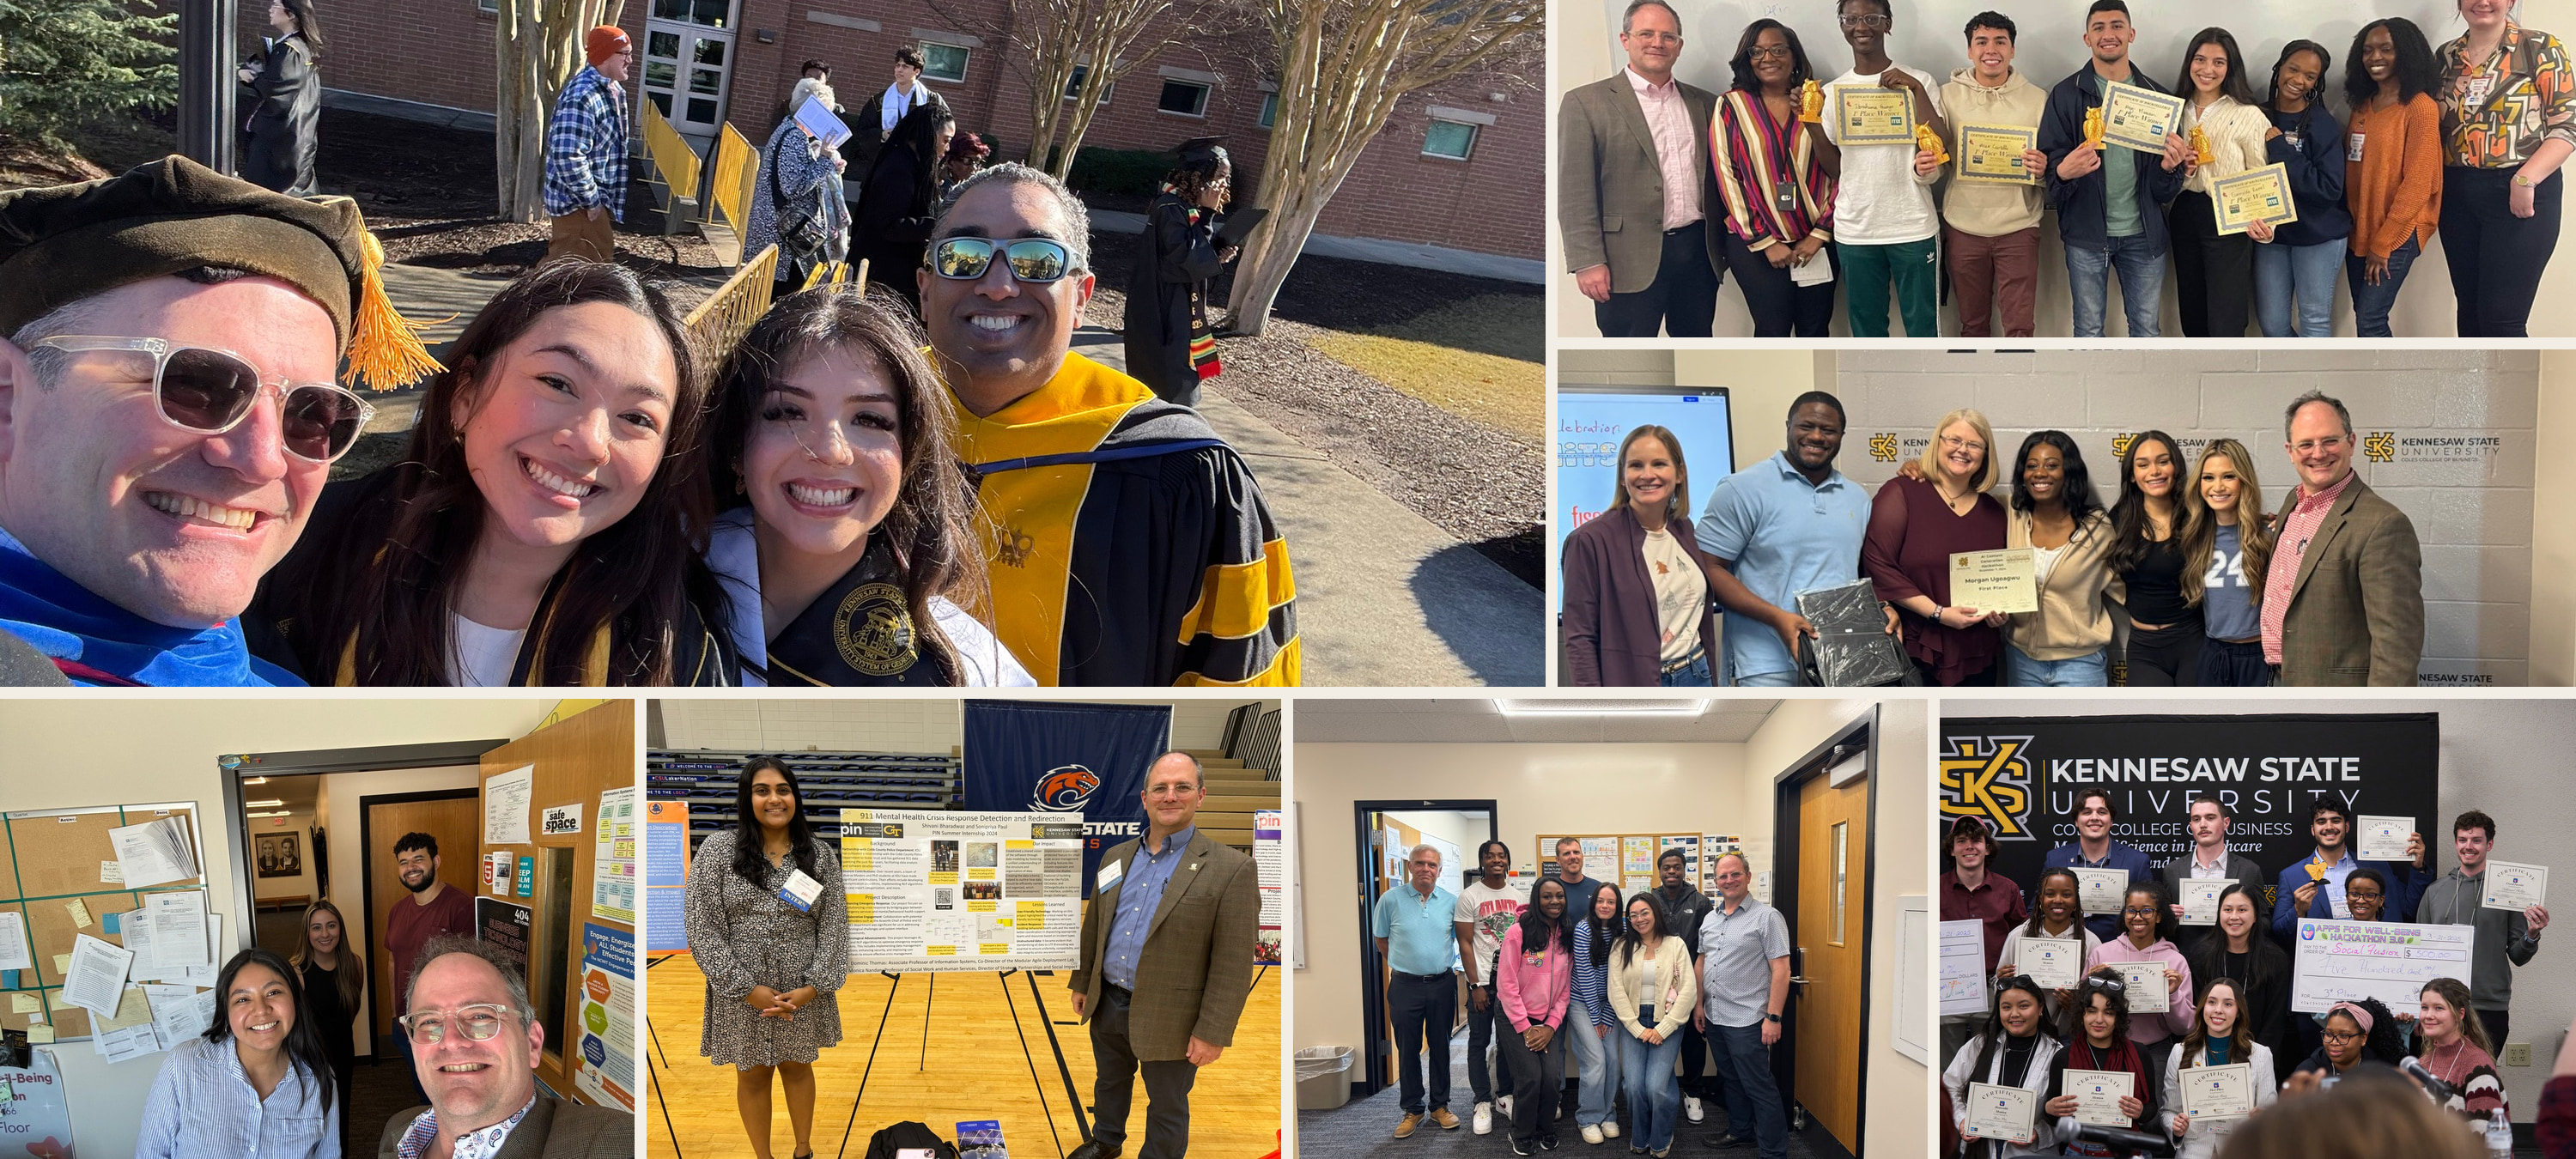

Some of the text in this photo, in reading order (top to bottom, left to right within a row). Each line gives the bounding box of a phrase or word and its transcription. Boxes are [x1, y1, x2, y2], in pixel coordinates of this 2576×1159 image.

[2402, 437, 2500, 446] KENNESAW STATE
[2402, 447, 2500, 456] UNIVERSITY
[2204, 550, 2251, 588] 24
[2419, 674, 2493, 683] NESAW STATE
[2052, 757, 2360, 783] KENNESAW STATE
[2052, 789, 2360, 815] UIVERSITY
[549, 809, 565, 821] safe
[1259, 814, 1280, 829] pin
[546, 818, 577, 833] space
[841, 822, 862, 835] pin
[1083, 822, 1141, 835] STATE
[2109, 823, 2182, 836] COLLEGE
[2120, 840, 2168, 853] Science
[2172, 839, 2185, 852] in
[2080, 874, 2117, 885] CERTIFICATE
[784, 892, 807, 908] INTERN
[515, 909, 529, 922] 404
[590, 931, 610, 942] Engage,
[2316, 924, 2421, 937] APPS FOR WELL-BEING
[2330, 933, 2387, 943] HACKATHON
[599, 941, 635, 956] ALL Students
[2028, 942, 2068, 954] CERTIFICATE
[2332, 942, 2400, 957] Social Fusion
[602, 950, 625, 963] Effective
[2077, 1075, 2120, 1089] CERTIFICATE
[2194, 1072, 2237, 1086] CERTIFICATE
[1982, 1090, 2023, 1105] CERTIFICATE
